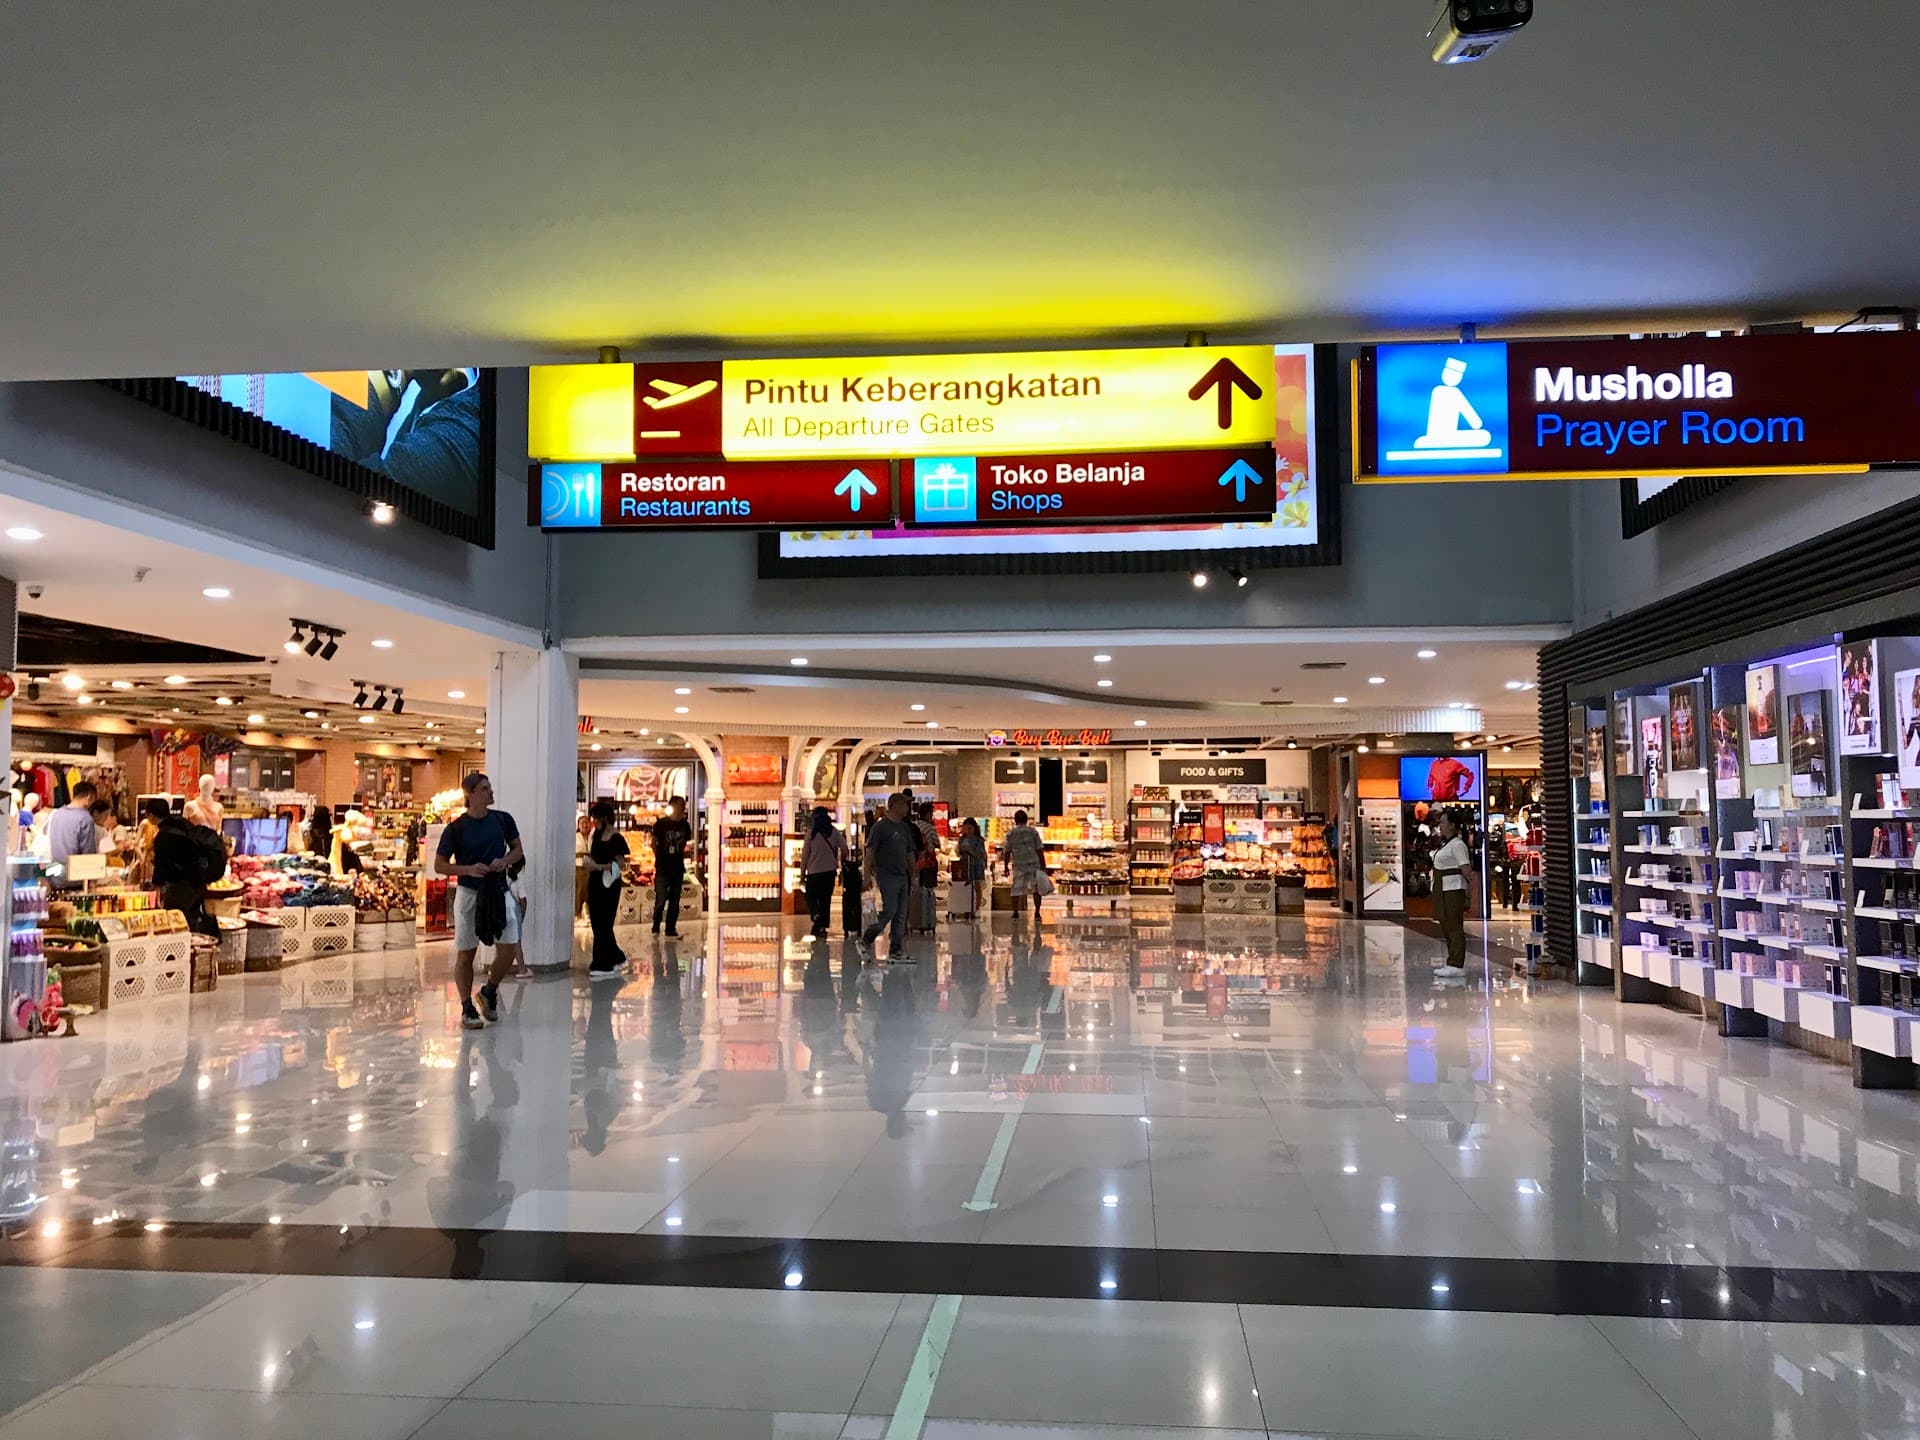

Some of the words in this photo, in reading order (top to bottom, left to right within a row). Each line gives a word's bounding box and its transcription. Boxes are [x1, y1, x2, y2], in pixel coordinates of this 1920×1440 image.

[745, 379, 828, 405] Pintu
[842, 373, 1101, 407] Keberangkatan
[1534, 363, 1734, 403] Musholla
[743, 416, 773, 438] All
[784, 415, 909, 440] Departure
[919, 412, 995, 435] Gates
[1535, 413, 1668, 455] Prayer
[1681, 410, 1806, 446] Room
[619, 472, 726, 493] Restoran
[990, 465, 1048, 485] Toko
[1054, 462, 1144, 486] Belanja
[619, 496, 751, 517] Restaurants
[991, 491, 1063, 513] Shops
[1013, 729, 1043, 751] Buy
[1078, 728, 1111, 746] Bali
[1180, 767, 1206, 777] FOOD
[1207, 767, 1216, 777] &
[1218, 767, 1245, 777] GIFTS
